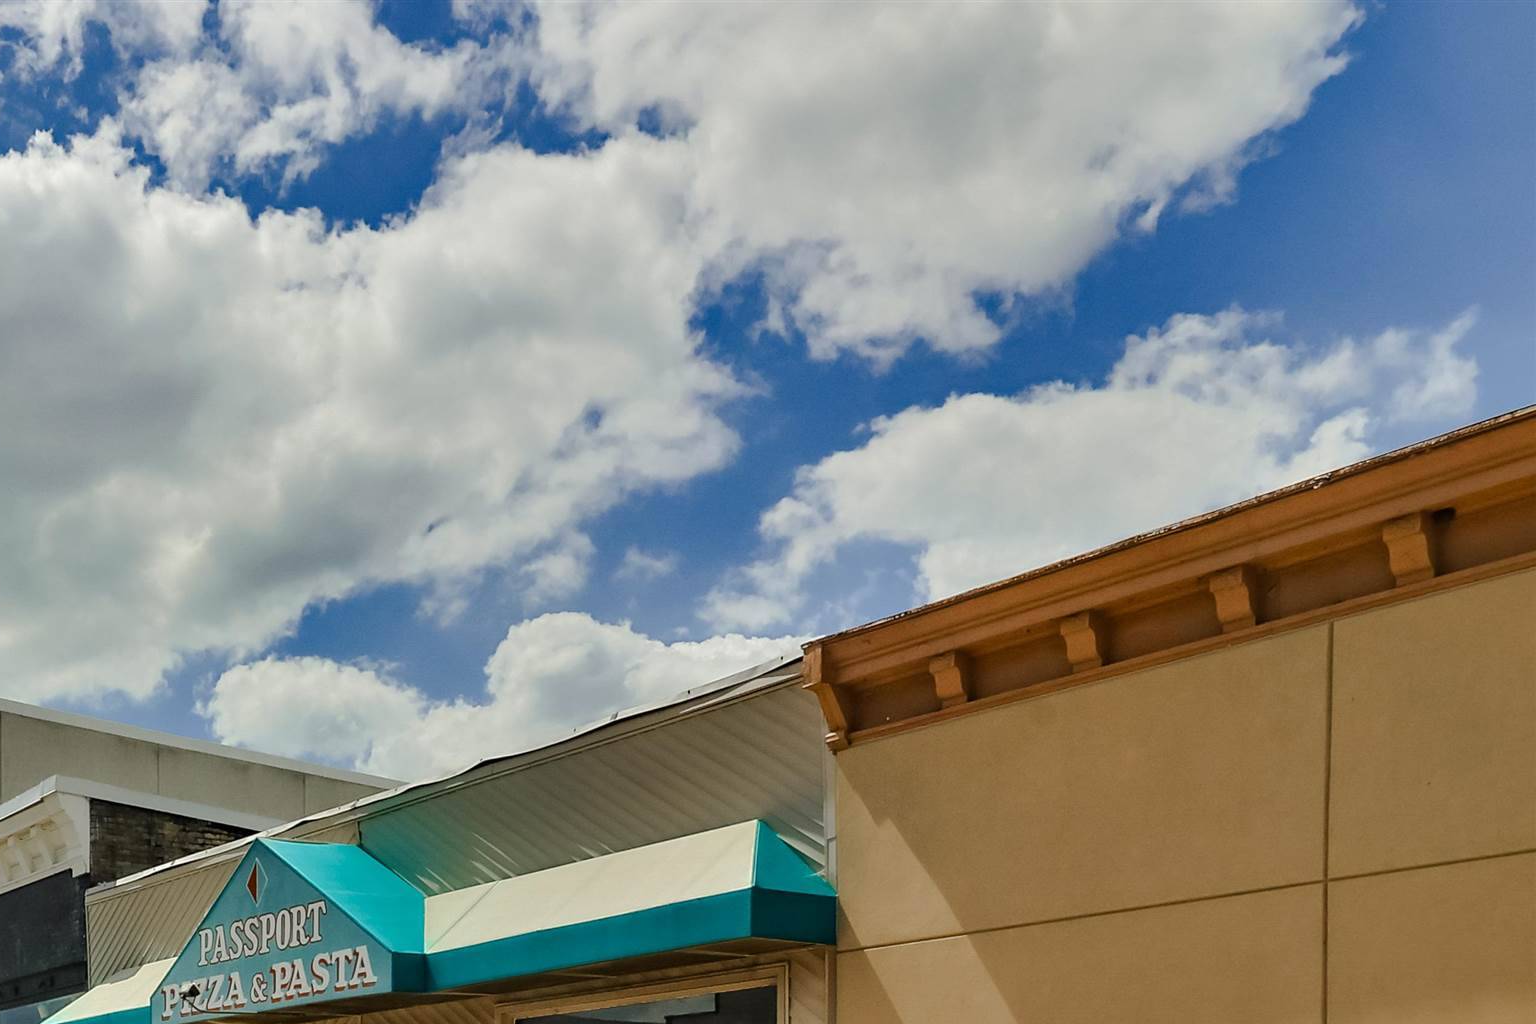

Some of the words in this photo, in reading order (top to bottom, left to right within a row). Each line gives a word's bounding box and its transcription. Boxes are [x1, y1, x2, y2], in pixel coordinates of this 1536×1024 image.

[198, 900, 327, 967] PASSPORT
[250, 972, 267, 1004] &
[269, 945, 378, 1003] PASTA
